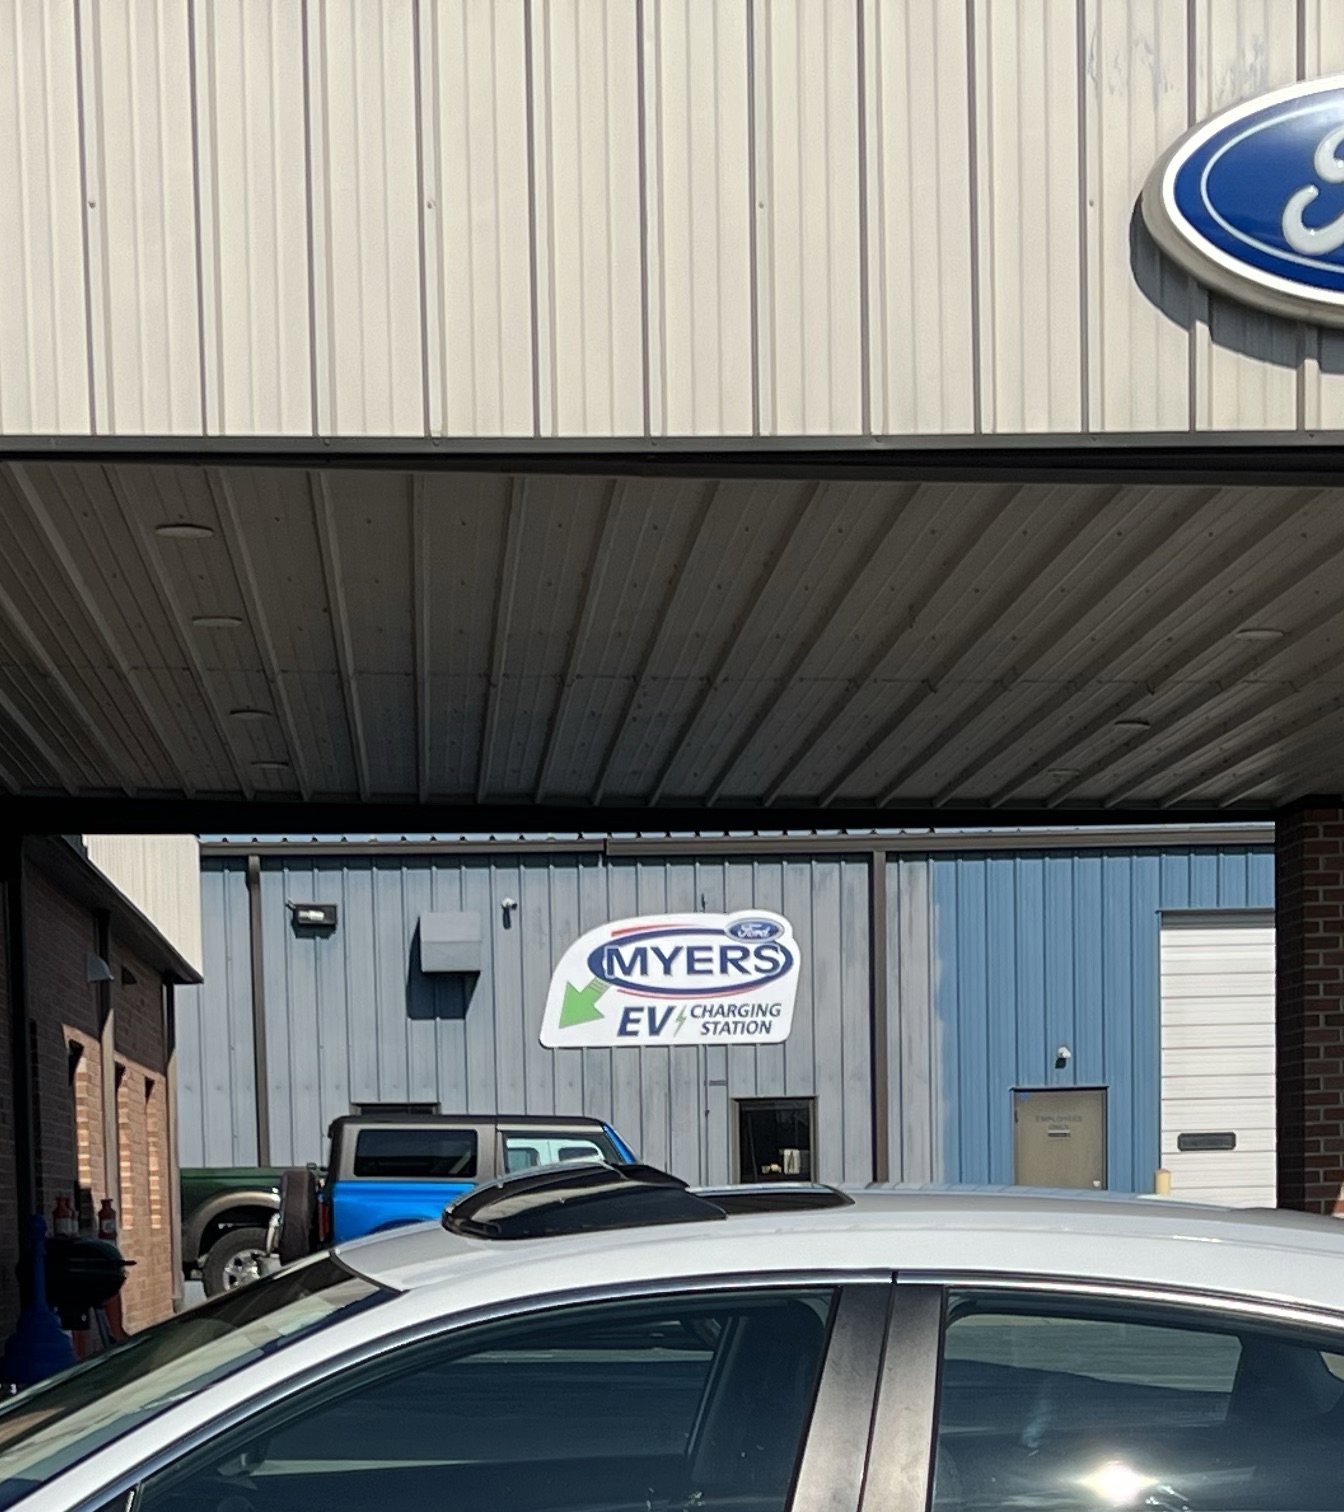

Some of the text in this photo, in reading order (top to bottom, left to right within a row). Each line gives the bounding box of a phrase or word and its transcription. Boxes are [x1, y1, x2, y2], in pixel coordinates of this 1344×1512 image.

[737, 923, 771, 938] Ford
[605, 944, 782, 977] MYERS
[690, 1003, 781, 1018] CHARGING
[617, 1005, 676, 1037] EV
[701, 1021, 772, 1036] STATION
